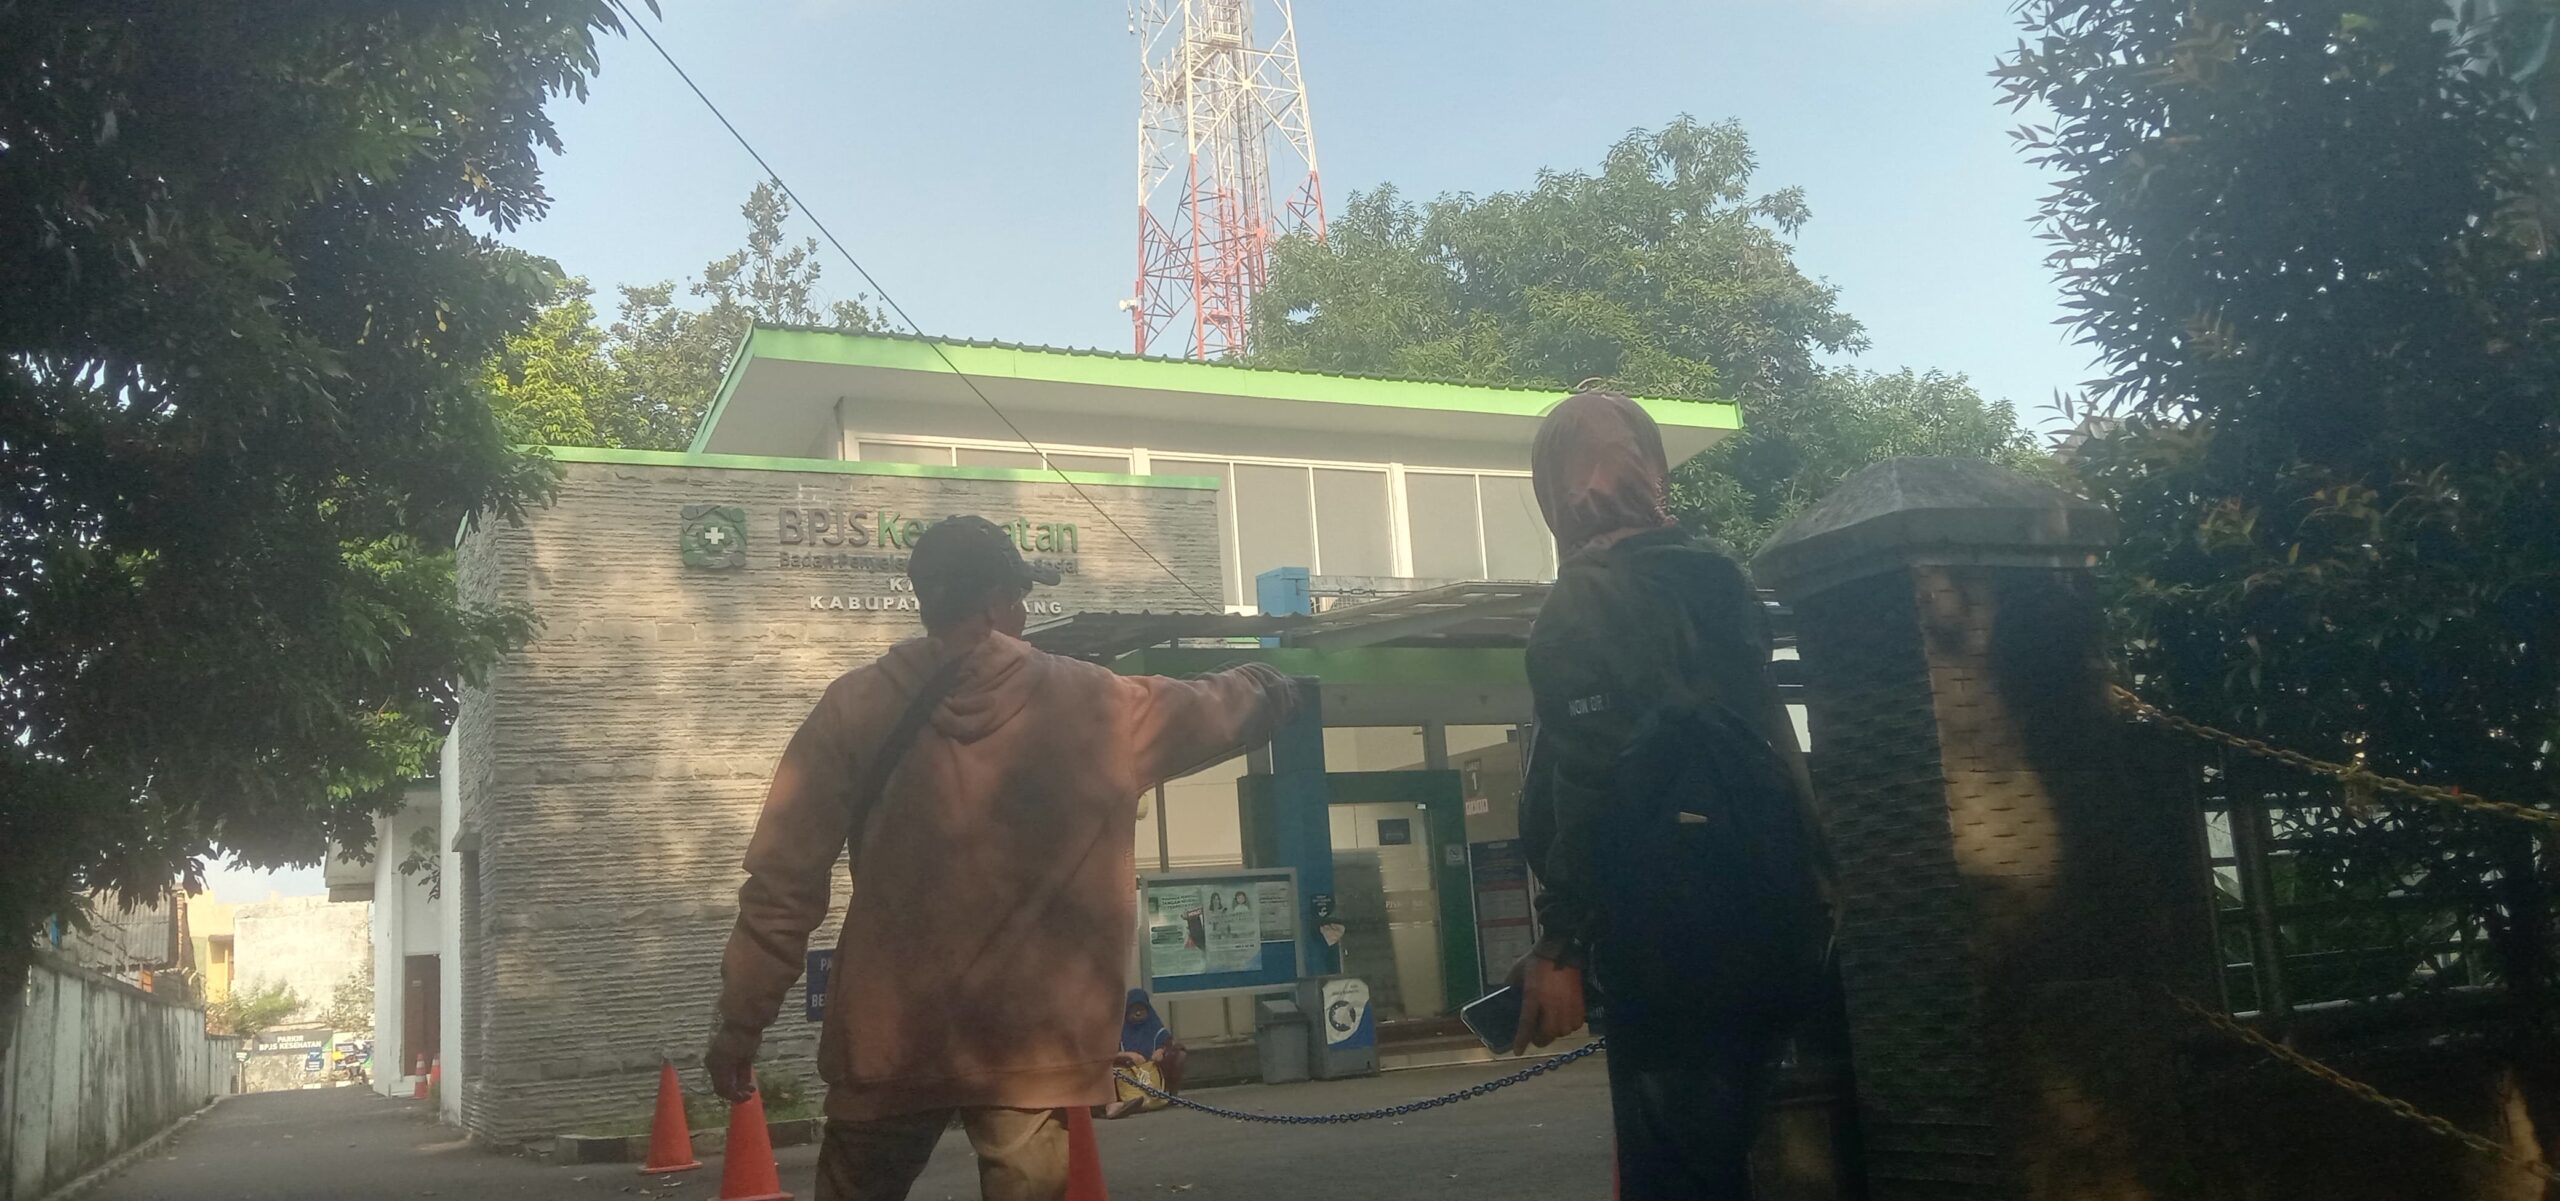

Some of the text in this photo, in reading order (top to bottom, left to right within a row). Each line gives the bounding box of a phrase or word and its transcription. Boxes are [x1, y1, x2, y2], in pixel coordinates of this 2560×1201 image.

[779, 507, 1078, 553] BPJS Keatan
[780, 552, 833, 568] Badan
[810, 595, 921, 611] KABUPAT
[259, 1041, 322, 1051] BPJS KESEHATAN
[277, 1035, 304, 1043] PARKIR
